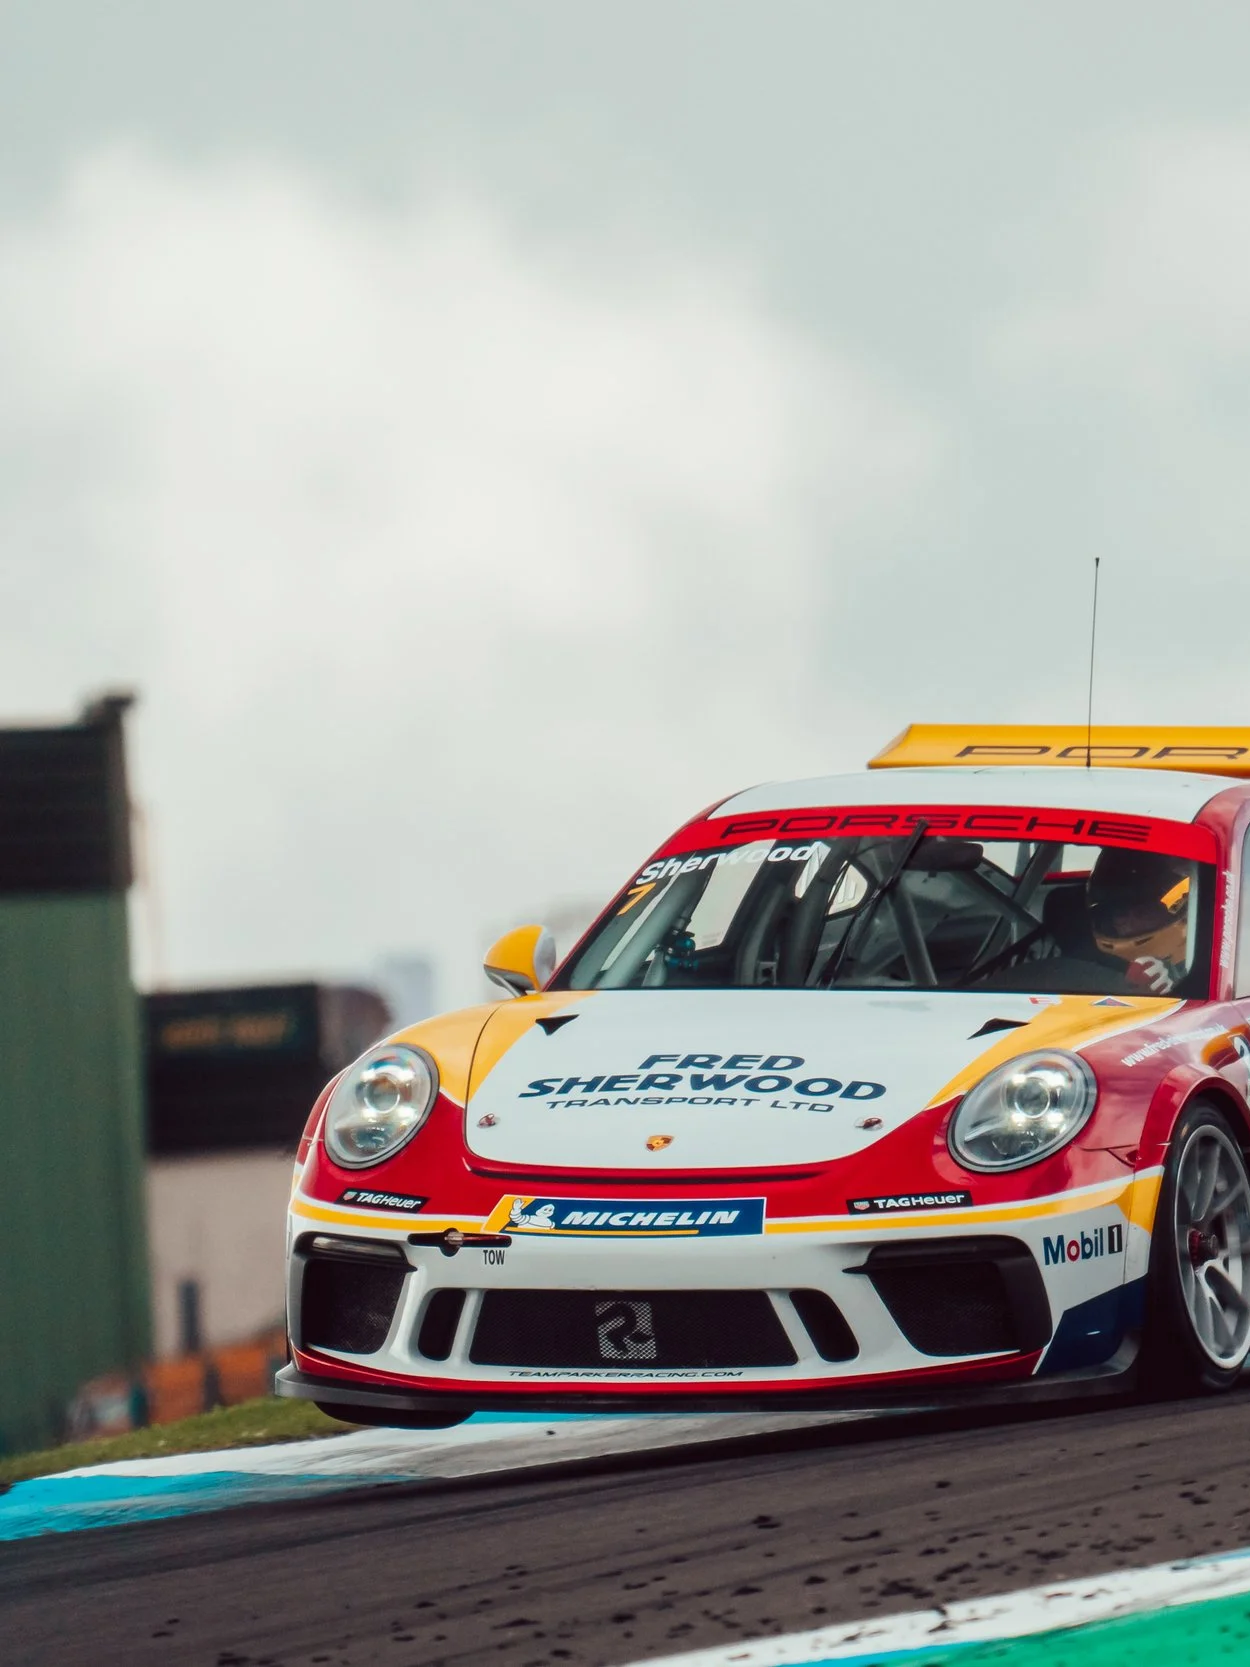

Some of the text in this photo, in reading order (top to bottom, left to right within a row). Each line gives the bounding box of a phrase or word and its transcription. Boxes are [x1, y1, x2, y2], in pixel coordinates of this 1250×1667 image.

[720, 813, 1151, 842] PORSCHE
[635, 842, 816, 885] Sherwood
[617, 882, 656, 916] 7
[638, 1054, 805, 1071] FRED
[518, 1073, 887, 1101] SHERWOOD
[547, 1097, 834, 1113] TRANSPORT LTD
[355, 1191, 422, 1209] TAGHeuer
[874, 1194, 965, 1209] TAGHeuer
[561, 1210, 741, 1226] MICHELIN
[1043, 1224, 1121, 1265] Mobil 1
[483, 1249, 505, 1265] TOW
[509, 1370, 743, 1378] TEAMPARKERRACING.COM
